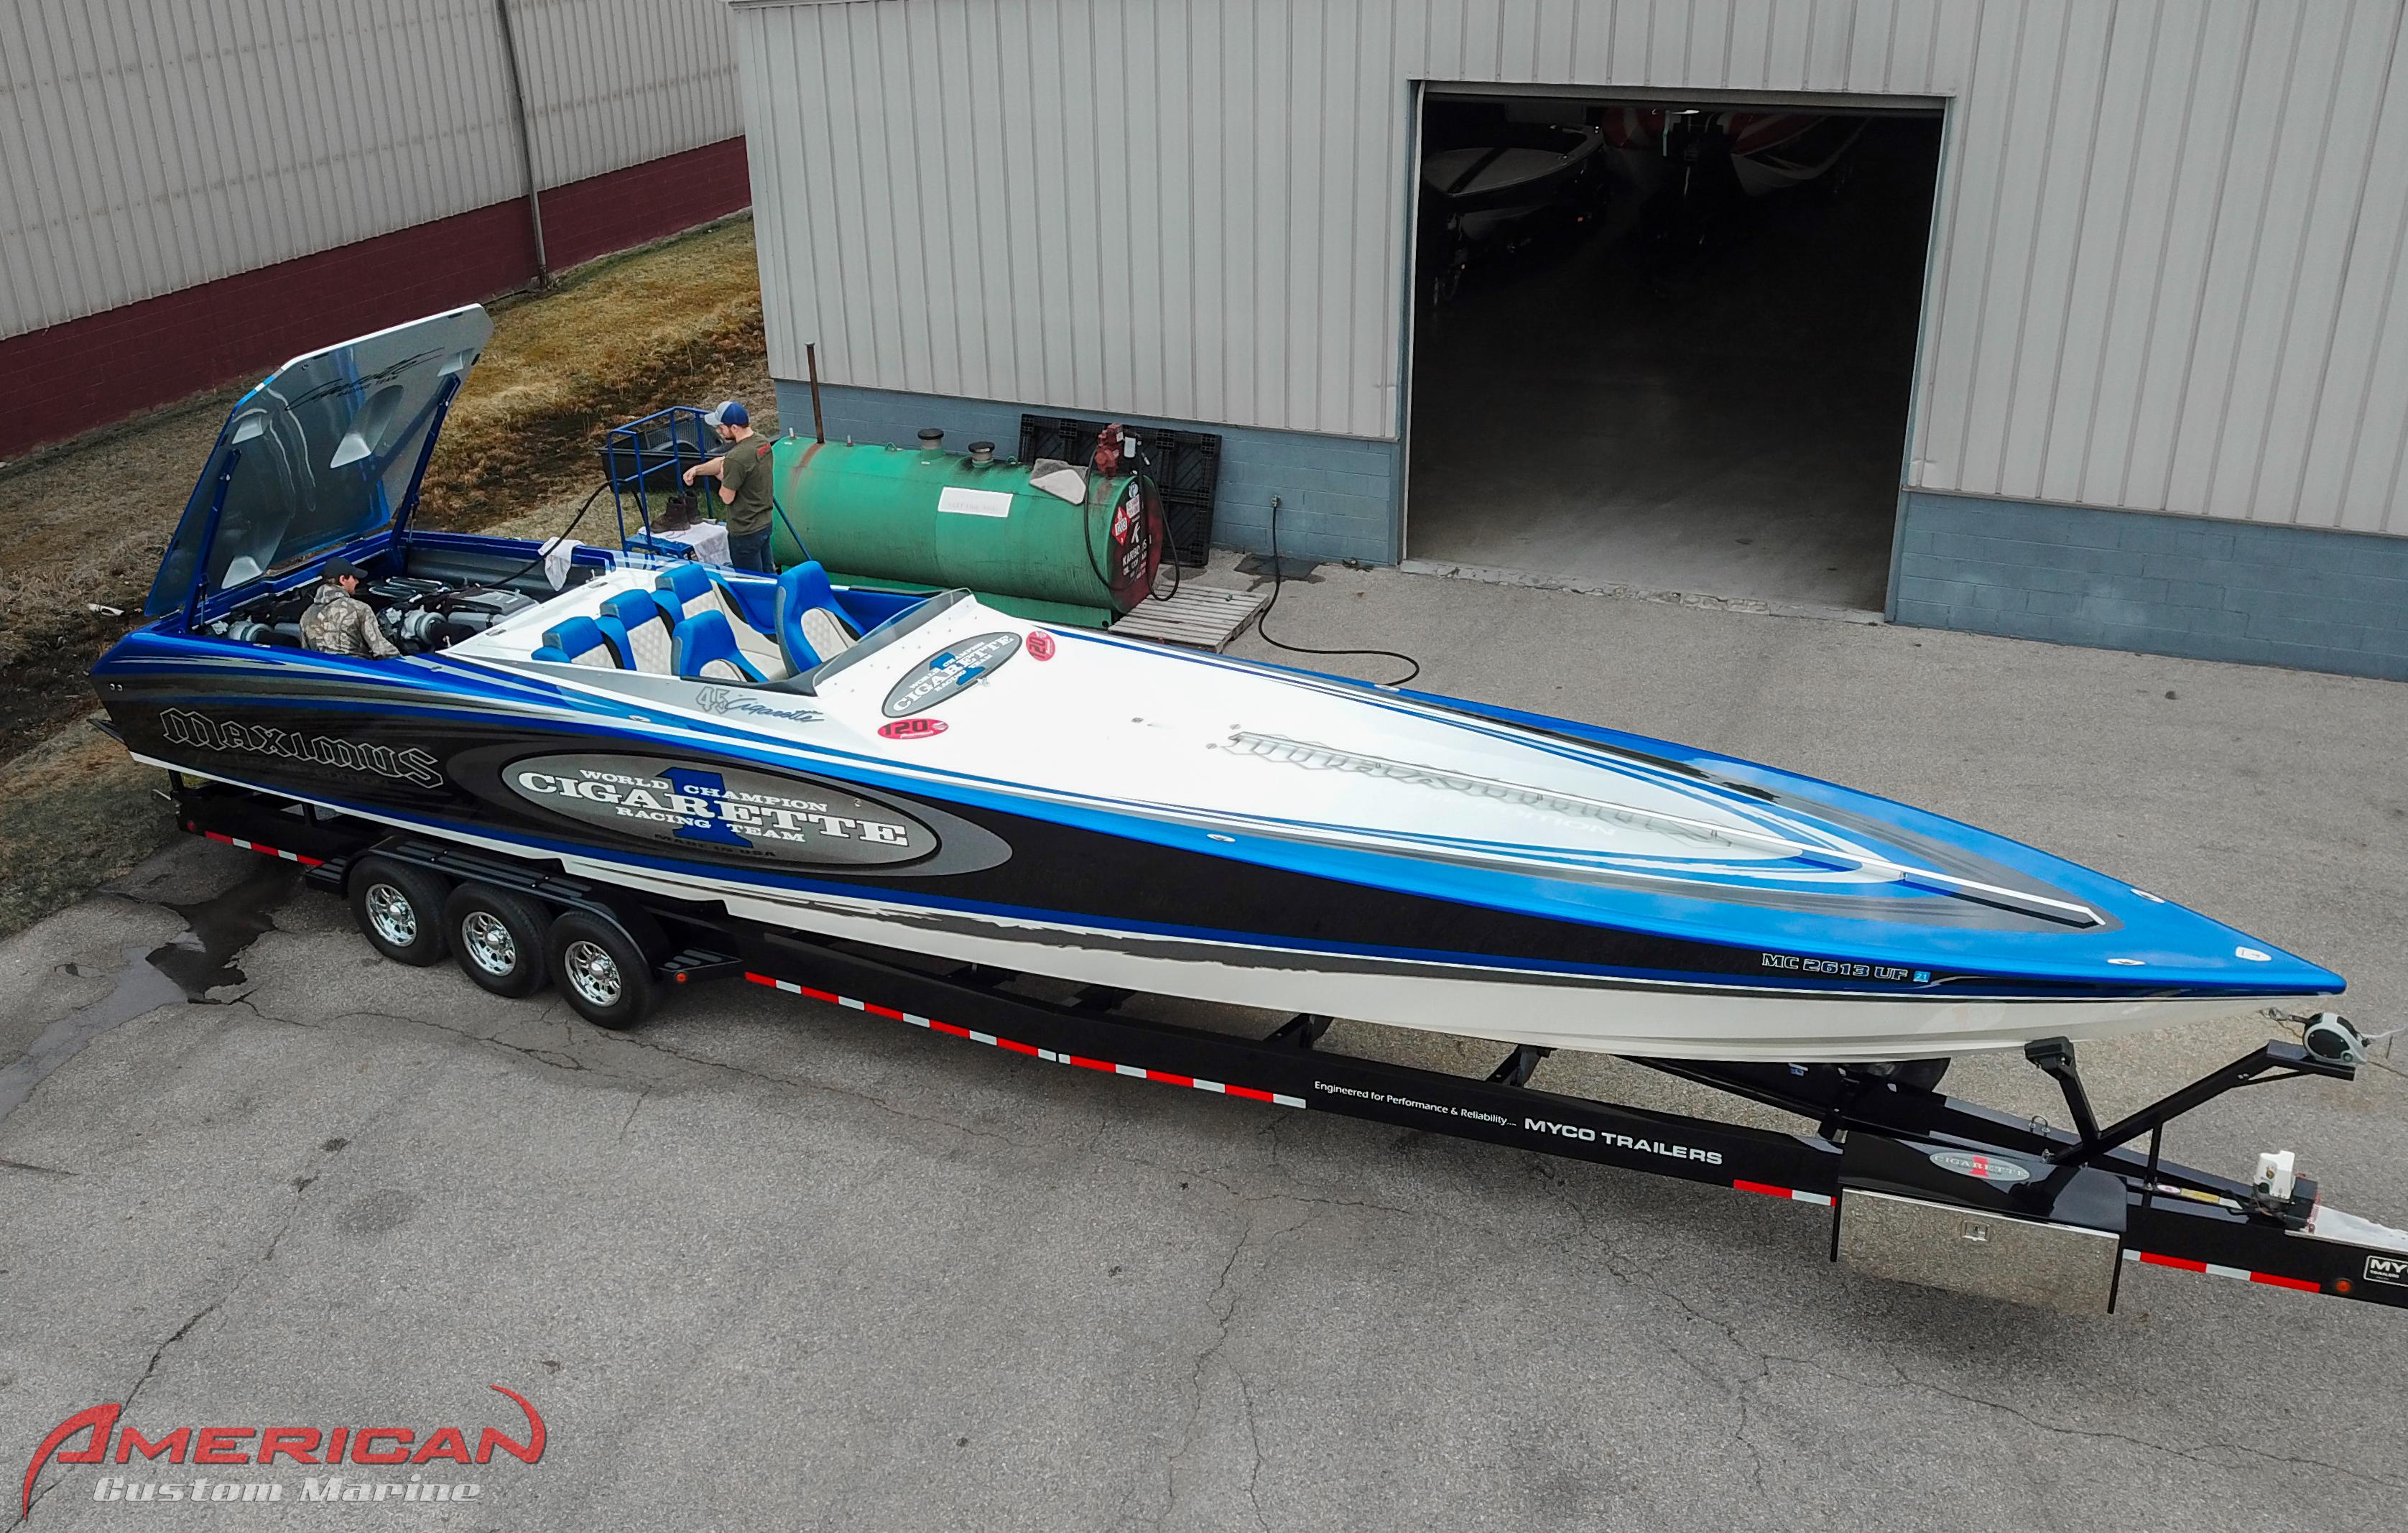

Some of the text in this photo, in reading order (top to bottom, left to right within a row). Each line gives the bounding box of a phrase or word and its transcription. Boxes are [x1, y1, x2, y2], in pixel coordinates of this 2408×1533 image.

[893, 635, 1014, 711] CIGARETTE
[695, 686, 730, 715] 45
[884, 720, 928, 736] 120
[159, 708, 444, 789] MAXIMUS
[580, 770, 828, 812] WORLD CHAMPION
[518, 772, 909, 848] CIGARETTE
[615, 806, 805, 843] RACING TEAM
[1762, 953, 1908, 980] MC 2613 UF
[1915, 972, 1928, 981] 21
[1315, 1081, 1369, 1099] Engineered
[1371, 1091, 1385, 1102] for
[1386, 1094, 1448, 1113] Performance
[1450, 1107, 1458, 1116] &
[1524, 1118, 1723, 1165] MYCO TRAILERS
[1935, 1155, 2027, 1177] CIGARETTE
[2371, 1259, 2408, 1274] MY
